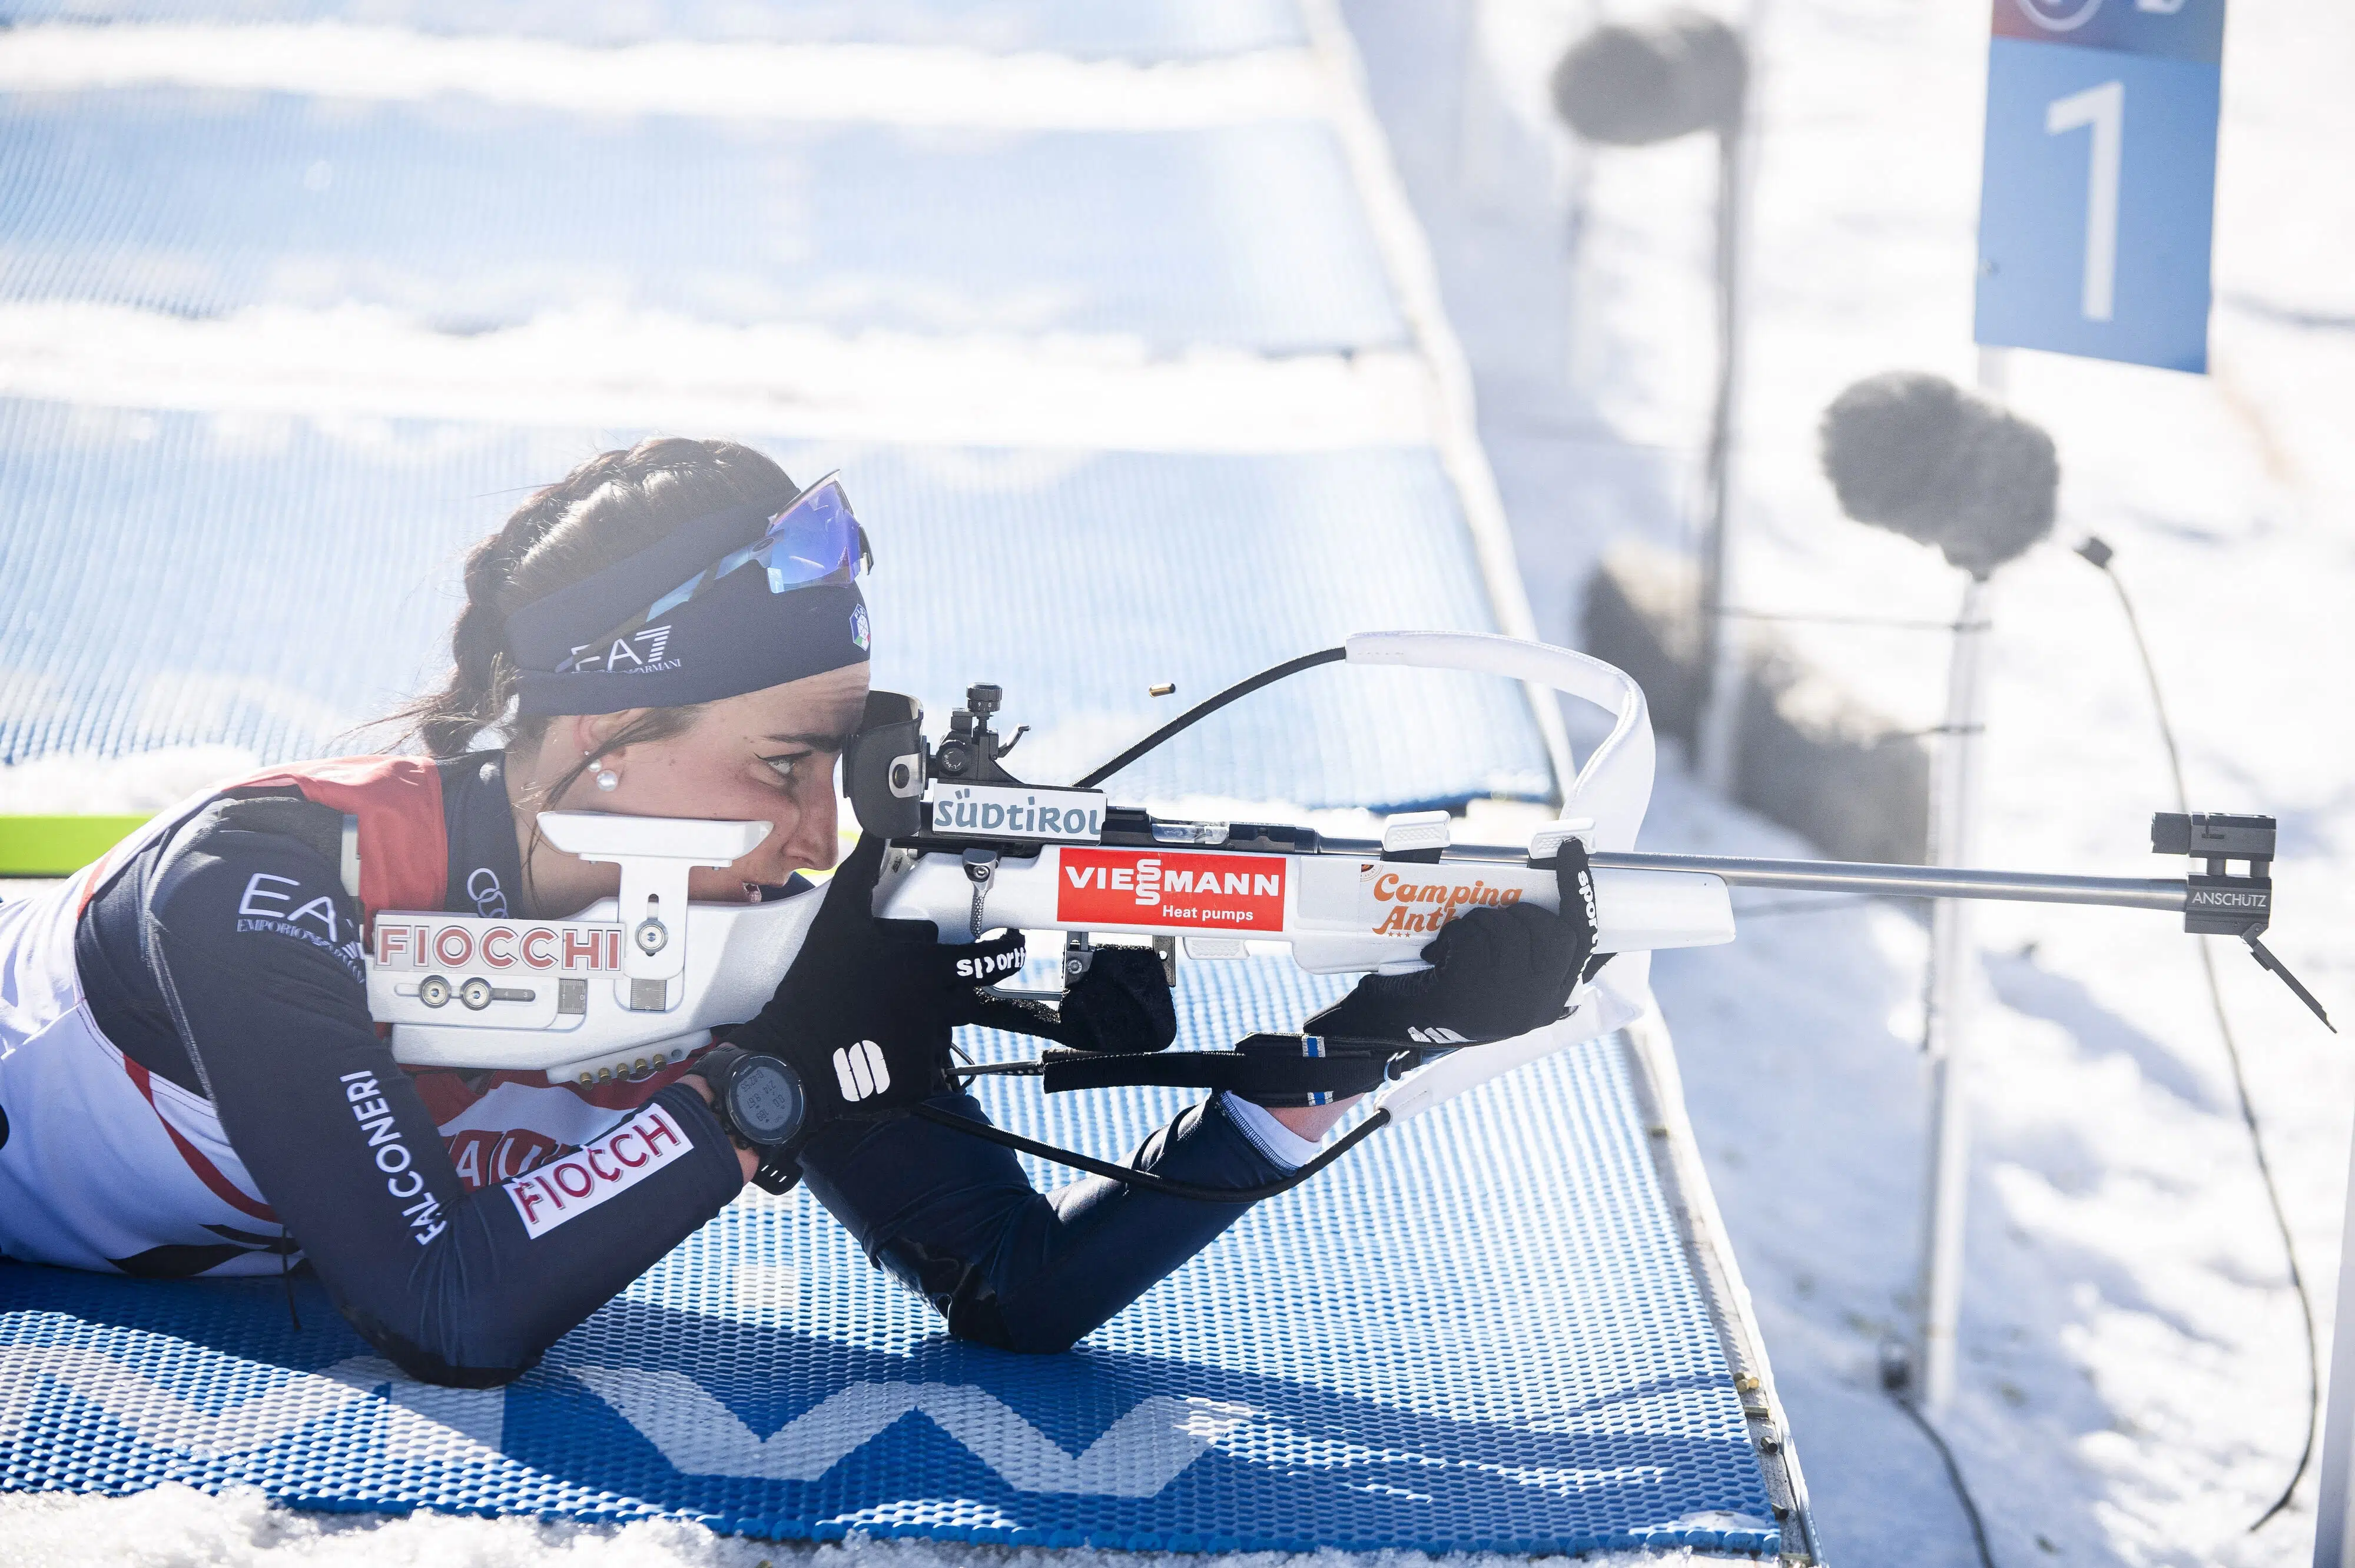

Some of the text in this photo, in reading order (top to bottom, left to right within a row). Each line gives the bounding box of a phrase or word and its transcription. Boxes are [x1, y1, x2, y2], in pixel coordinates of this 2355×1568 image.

[2046, 80, 2124, 322] 1
[1064, 859, 1279, 906] VIESSMANN
[1374, 873, 1523, 912] Camping
[2191, 891, 2267, 908] ANSCHÜTZ
[1162, 905, 1254, 923] Heat pumps
[375, 925, 623, 972] FIOCCHI
[340, 1070, 447, 1246] FALCONERI
